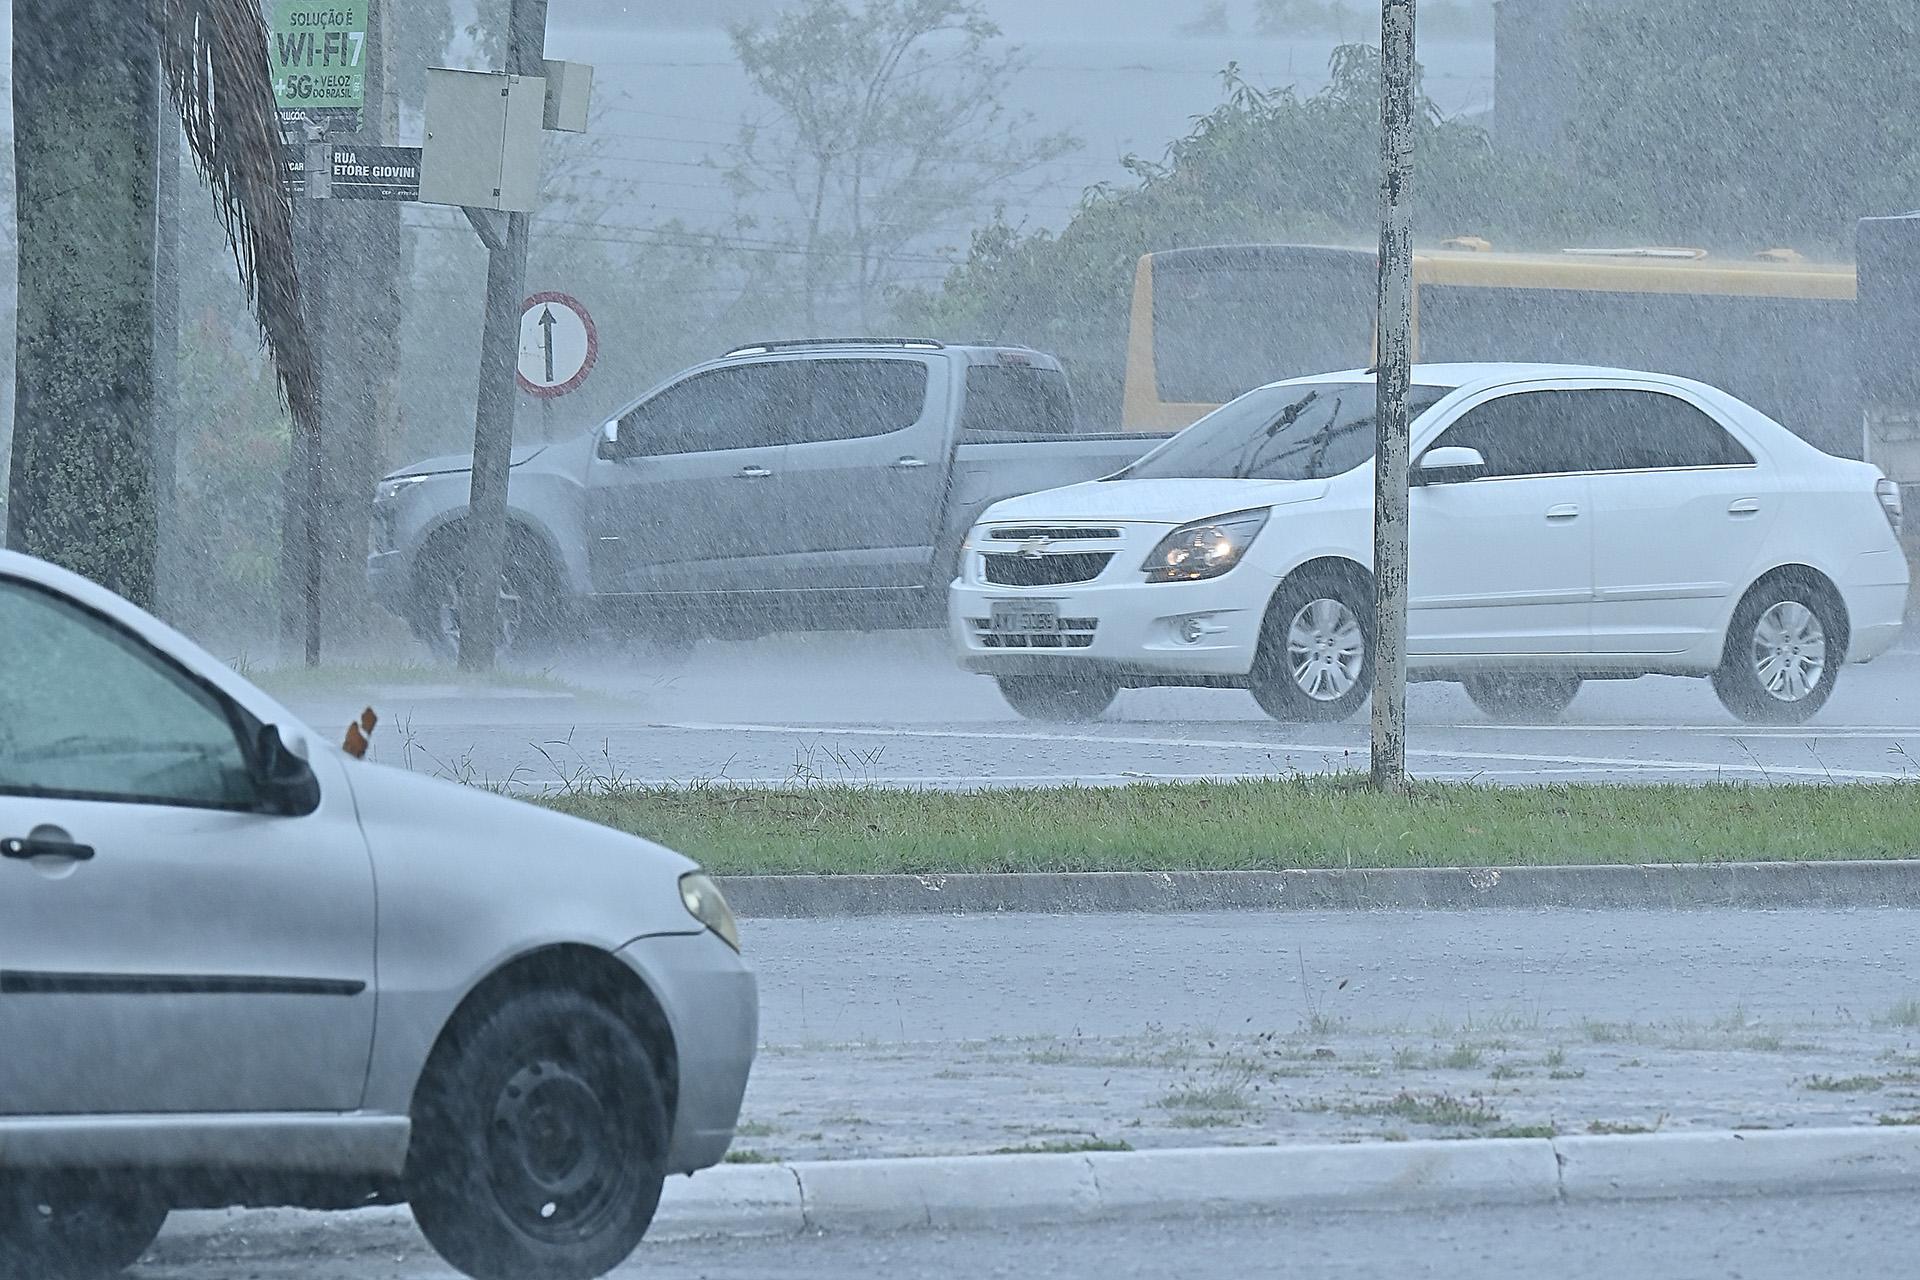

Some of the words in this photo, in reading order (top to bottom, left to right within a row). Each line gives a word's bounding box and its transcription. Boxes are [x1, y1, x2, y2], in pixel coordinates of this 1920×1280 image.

[290, 8, 344, 30] SOLUÇÃO
[346, 7, 353, 26] É
[320, 75, 351, 87] VELOZ
[312, 88, 325, 98] DO
[326, 88, 352, 98] BRASIL
[334, 152, 357, 164] RUA
[333, 164, 370, 177] ETORE
[372, 166, 415, 178] GIOVINI
